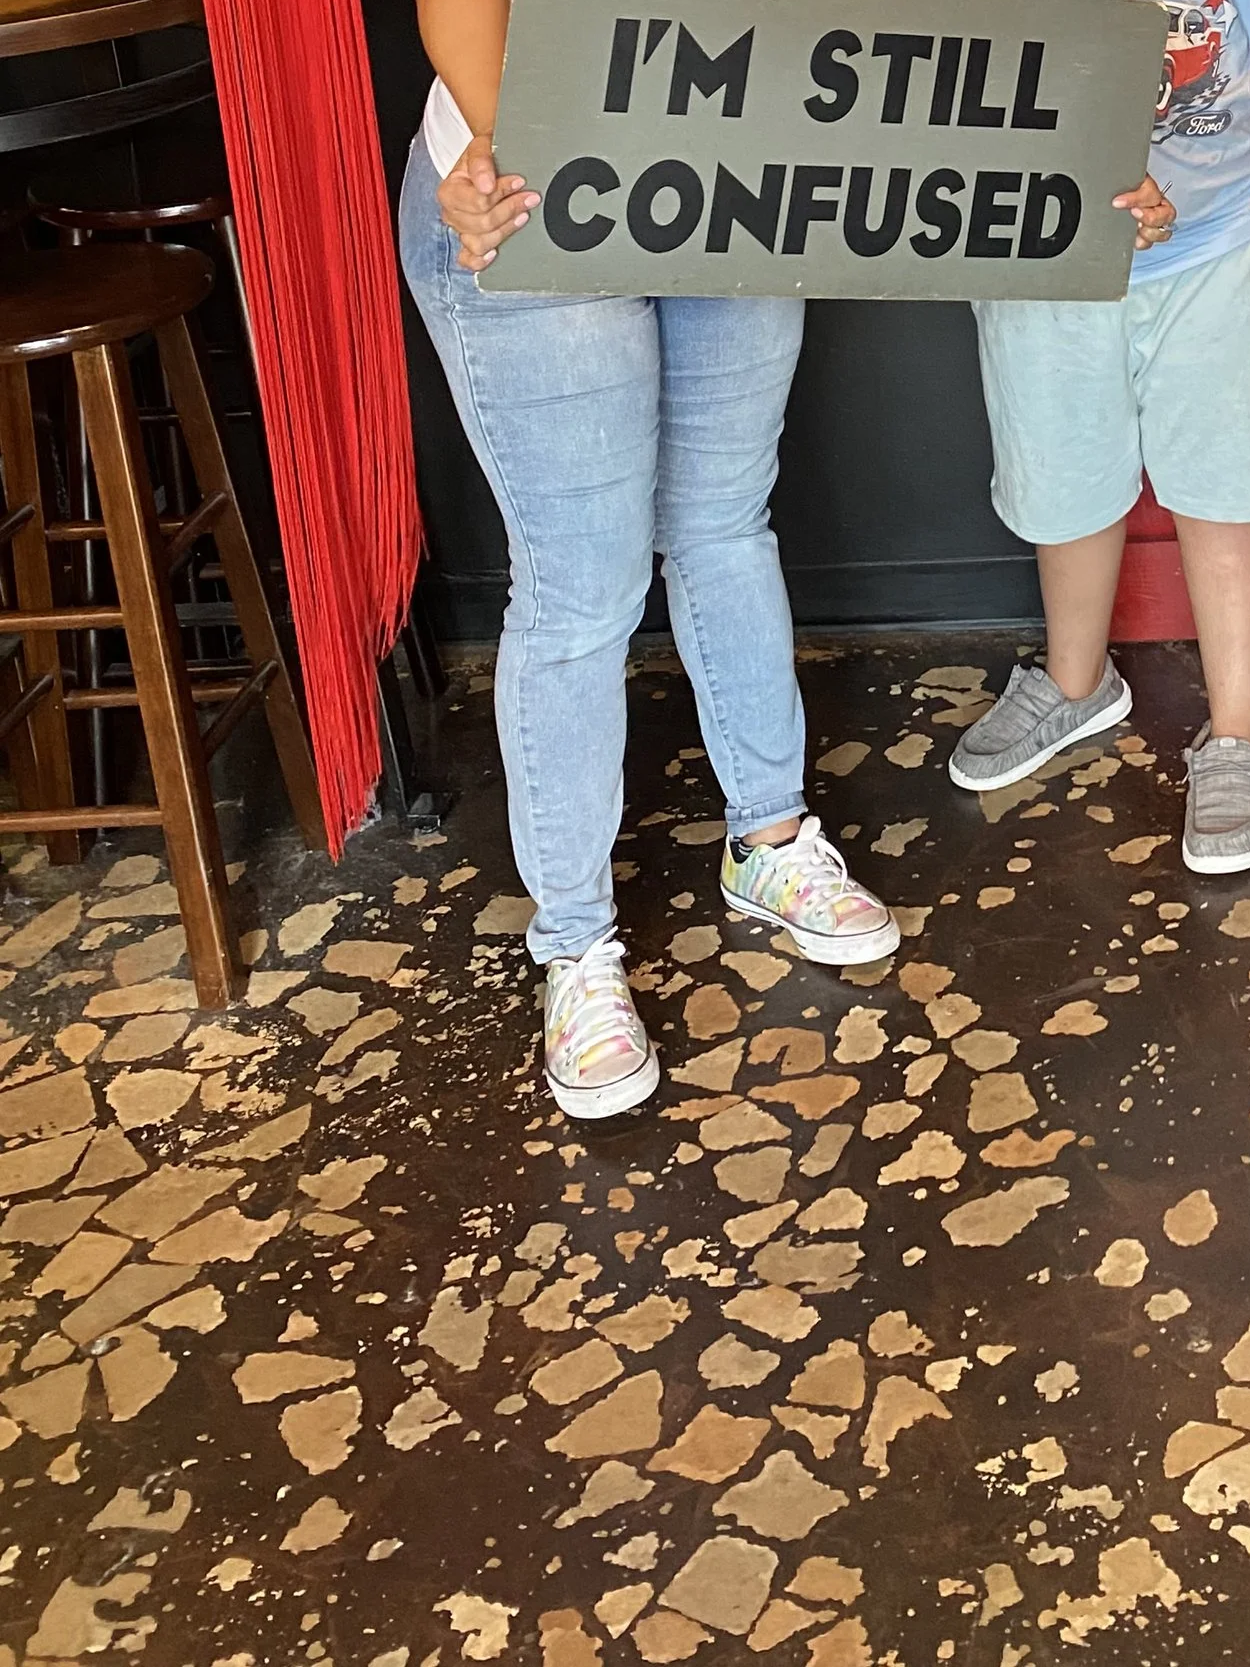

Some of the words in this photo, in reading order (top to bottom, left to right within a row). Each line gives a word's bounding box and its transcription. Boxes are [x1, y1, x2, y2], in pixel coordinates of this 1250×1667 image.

[602, 17, 756, 118] I'M
[803, 28, 1059, 131] STILL
[1186, 114, 1226, 135] Ford
[542, 156, 1083, 260] CONFUSED
